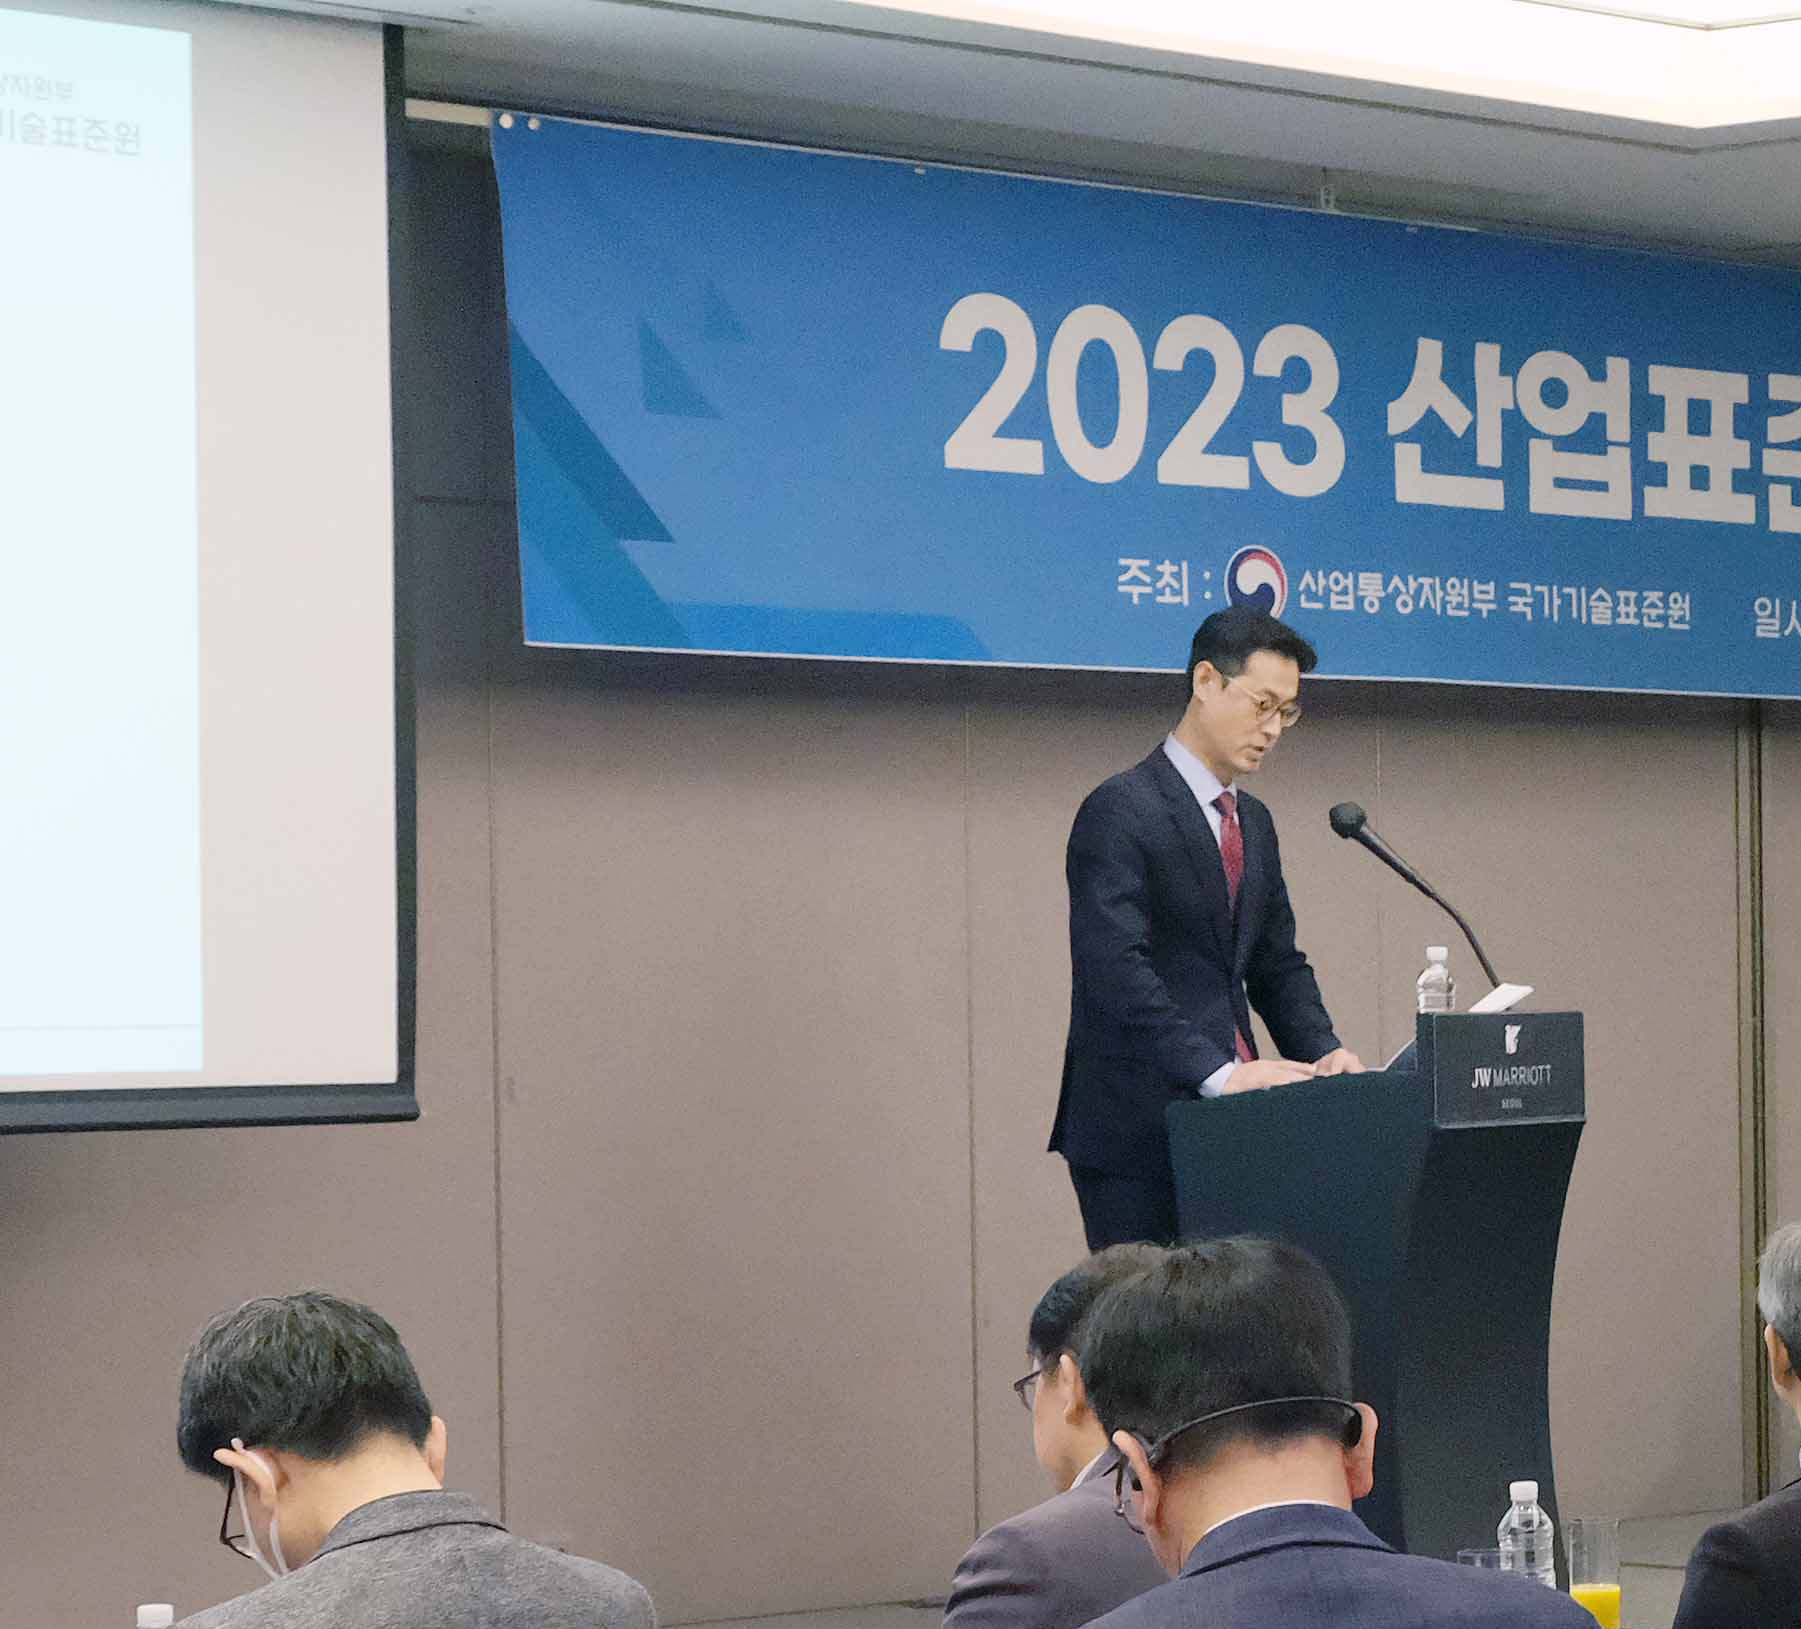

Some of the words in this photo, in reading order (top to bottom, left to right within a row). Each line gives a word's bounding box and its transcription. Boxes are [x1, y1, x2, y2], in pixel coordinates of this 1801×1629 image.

[939, 292, 1345, 498] 2023
[1117, 557, 1189, 605] 주최
[1298, 572, 1496, 618] 산업통상자원부
[1507, 582, 1691, 630] 국가기술표준원
